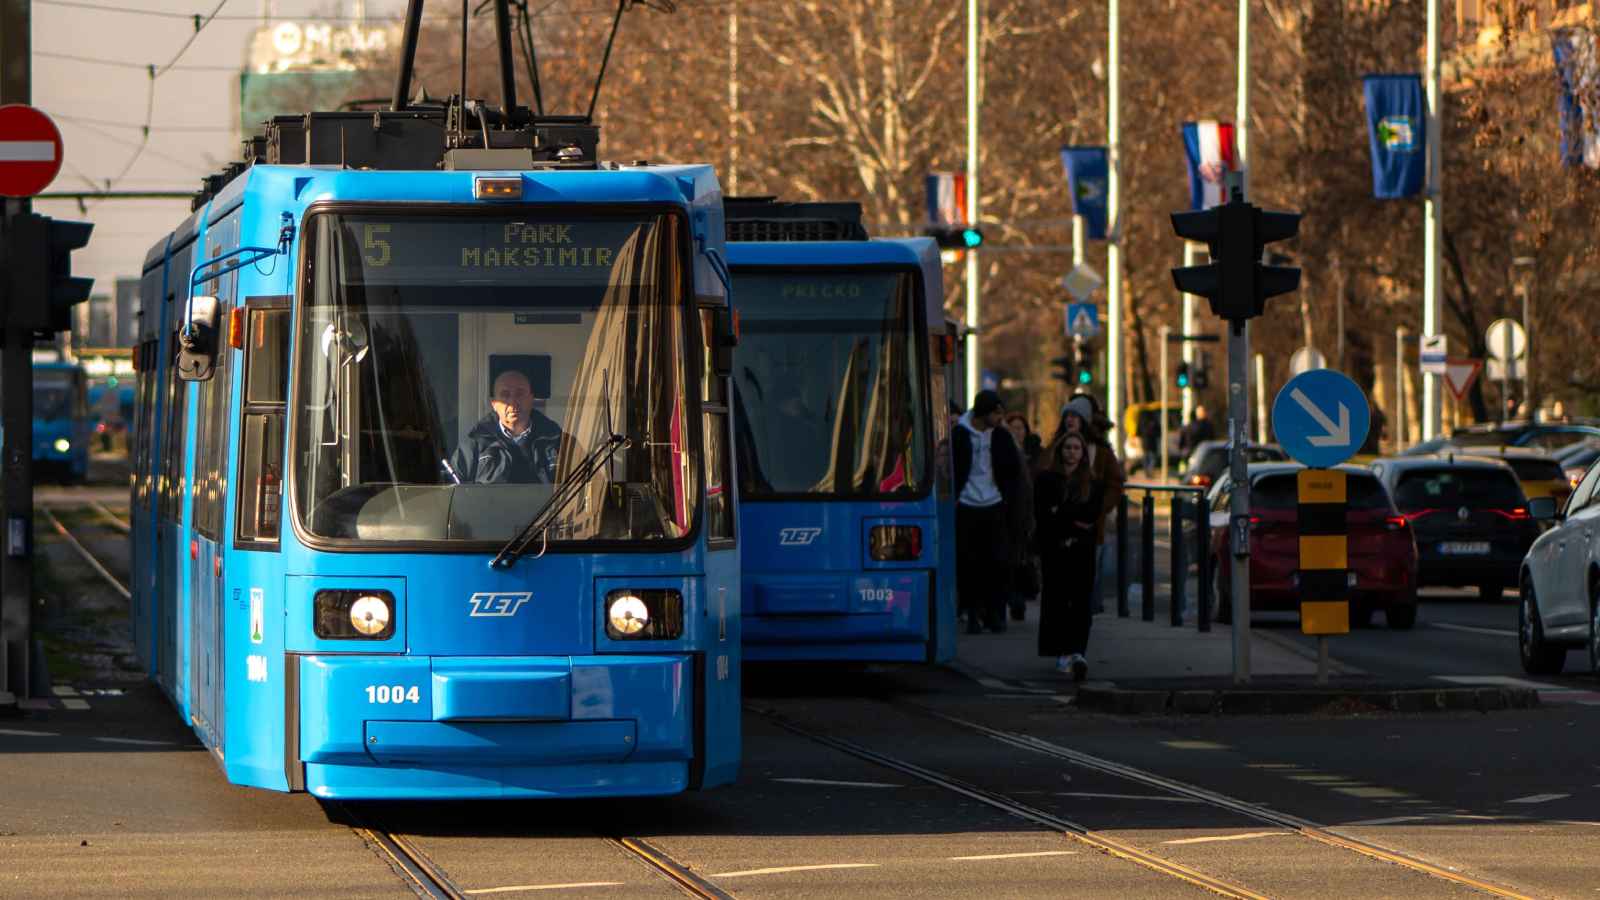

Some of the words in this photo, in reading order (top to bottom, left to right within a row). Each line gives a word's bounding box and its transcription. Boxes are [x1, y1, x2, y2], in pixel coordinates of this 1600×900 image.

[504, 224, 573, 243] PARK
[364, 224, 391, 266] 5
[461, 247, 612, 266] MAKSIMIR
[779, 527, 822, 545] ZET
[469, 591, 533, 616] ZET
[859, 588, 894, 601] 1003
[365, 685, 420, 704] 1004
